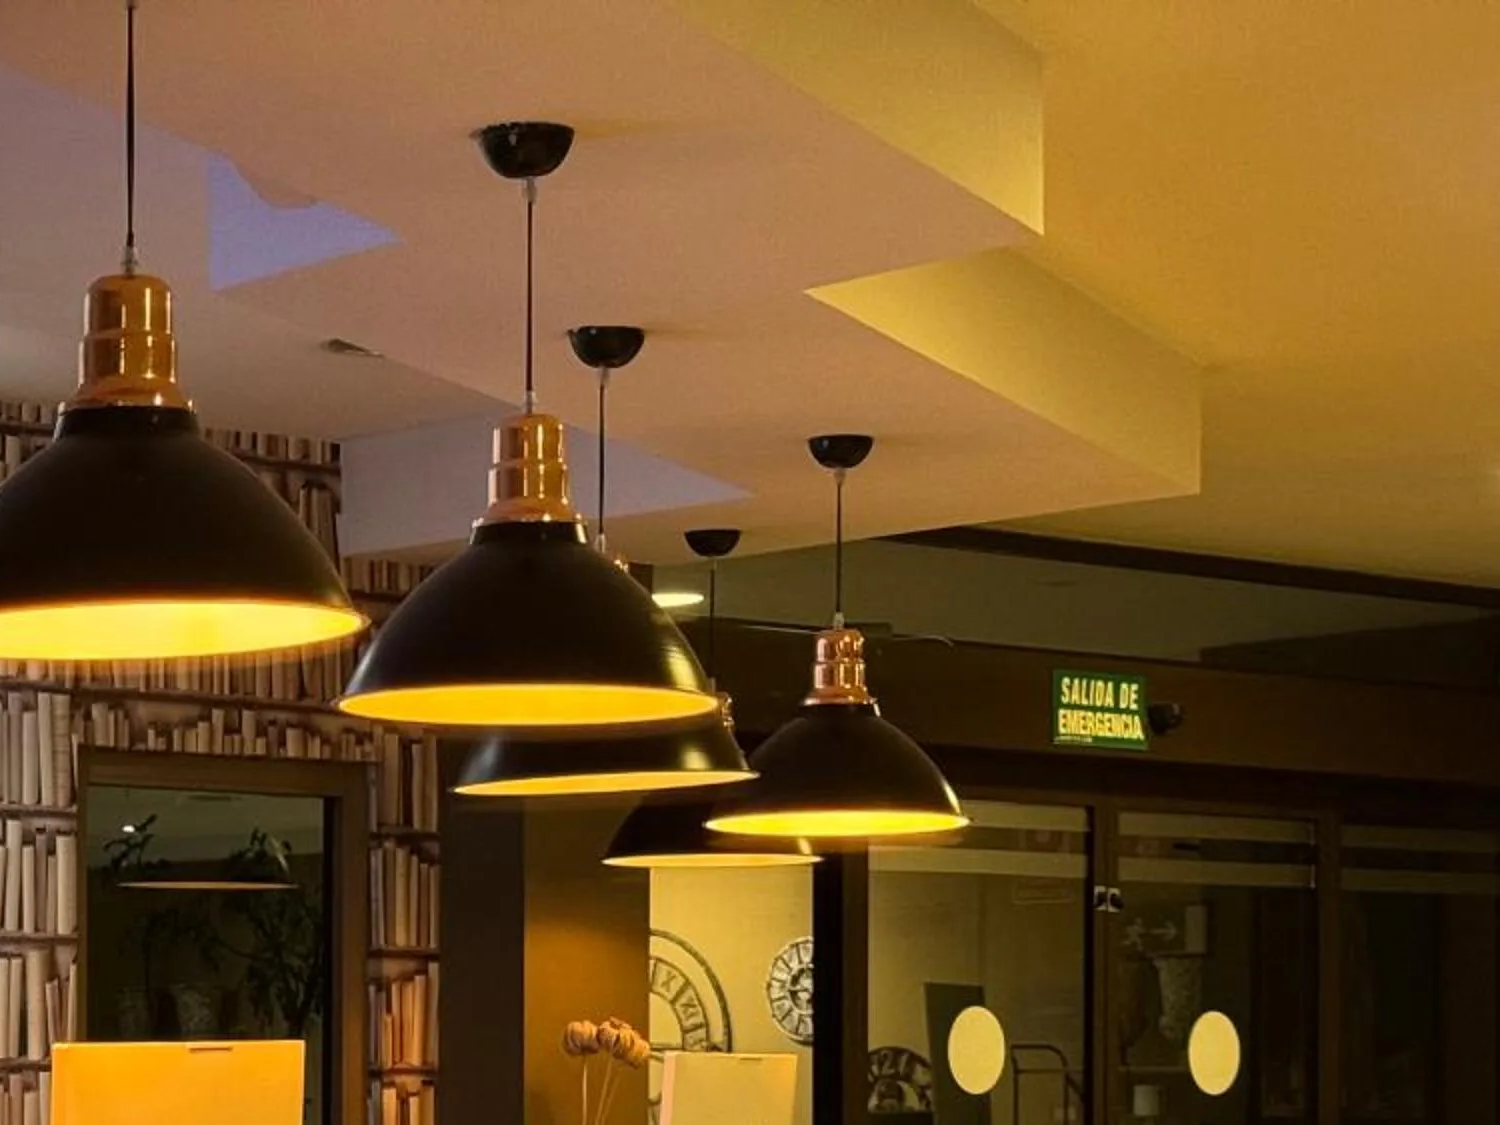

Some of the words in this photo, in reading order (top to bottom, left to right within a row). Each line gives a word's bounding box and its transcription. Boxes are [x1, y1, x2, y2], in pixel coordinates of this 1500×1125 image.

[1060, 676, 1114, 708] SALIDA
[1119, 683, 1139, 710] DE
[1058, 708, 1145, 740] EMERGENCIA
